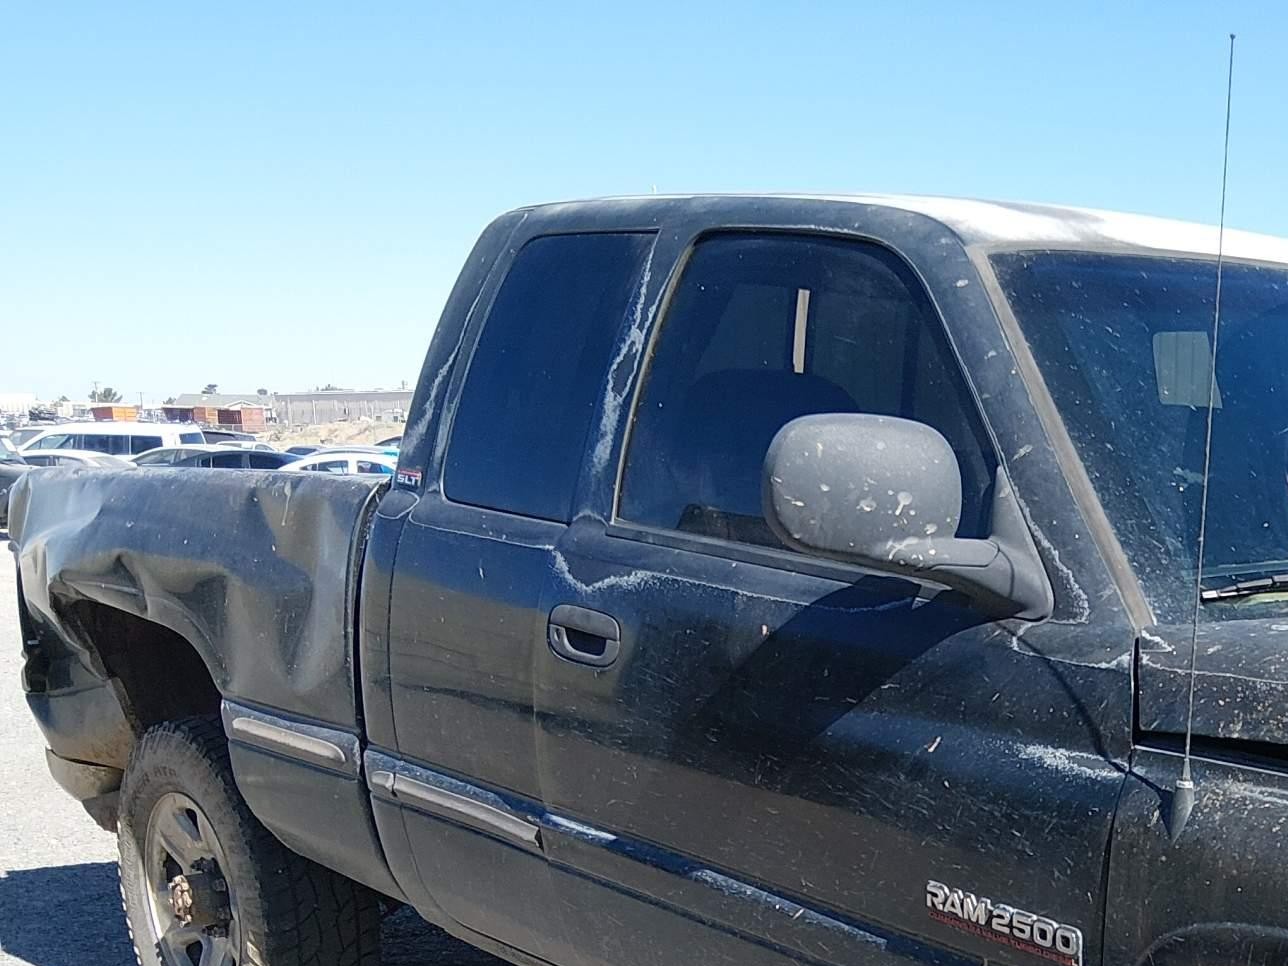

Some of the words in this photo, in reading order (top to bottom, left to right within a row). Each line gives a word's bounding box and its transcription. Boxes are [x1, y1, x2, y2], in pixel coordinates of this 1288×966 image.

[396, 474, 416, 486] SLT
[926, 879, 992, 925] RAM
[992, 903, 1082, 955] 2500
